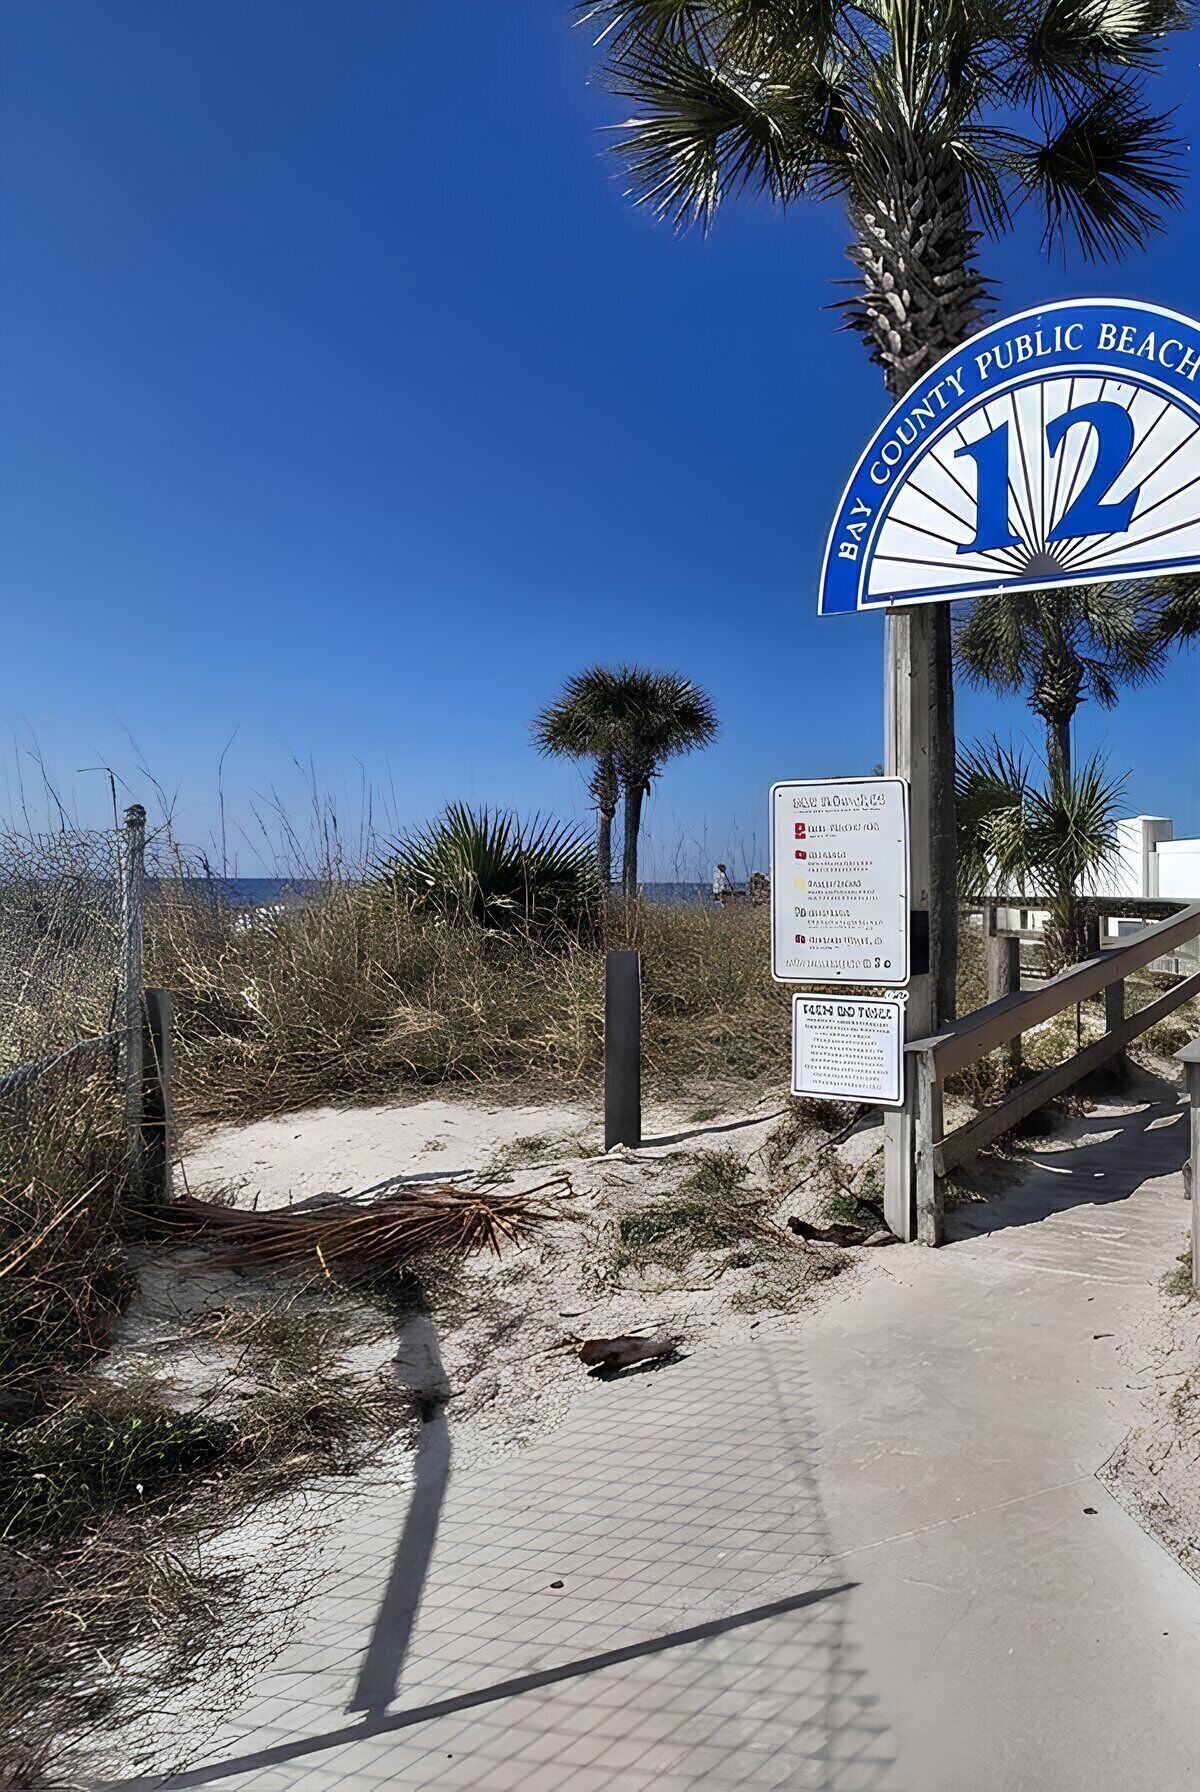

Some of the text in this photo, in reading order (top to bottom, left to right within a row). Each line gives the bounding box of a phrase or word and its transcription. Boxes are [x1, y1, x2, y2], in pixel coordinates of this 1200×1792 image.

[838, 497, 868, 562] BAY
[870, 366, 965, 485] COUNTY
[974, 323, 1084, 381] PUBLIC
[954, 400, 1141, 554] 12
